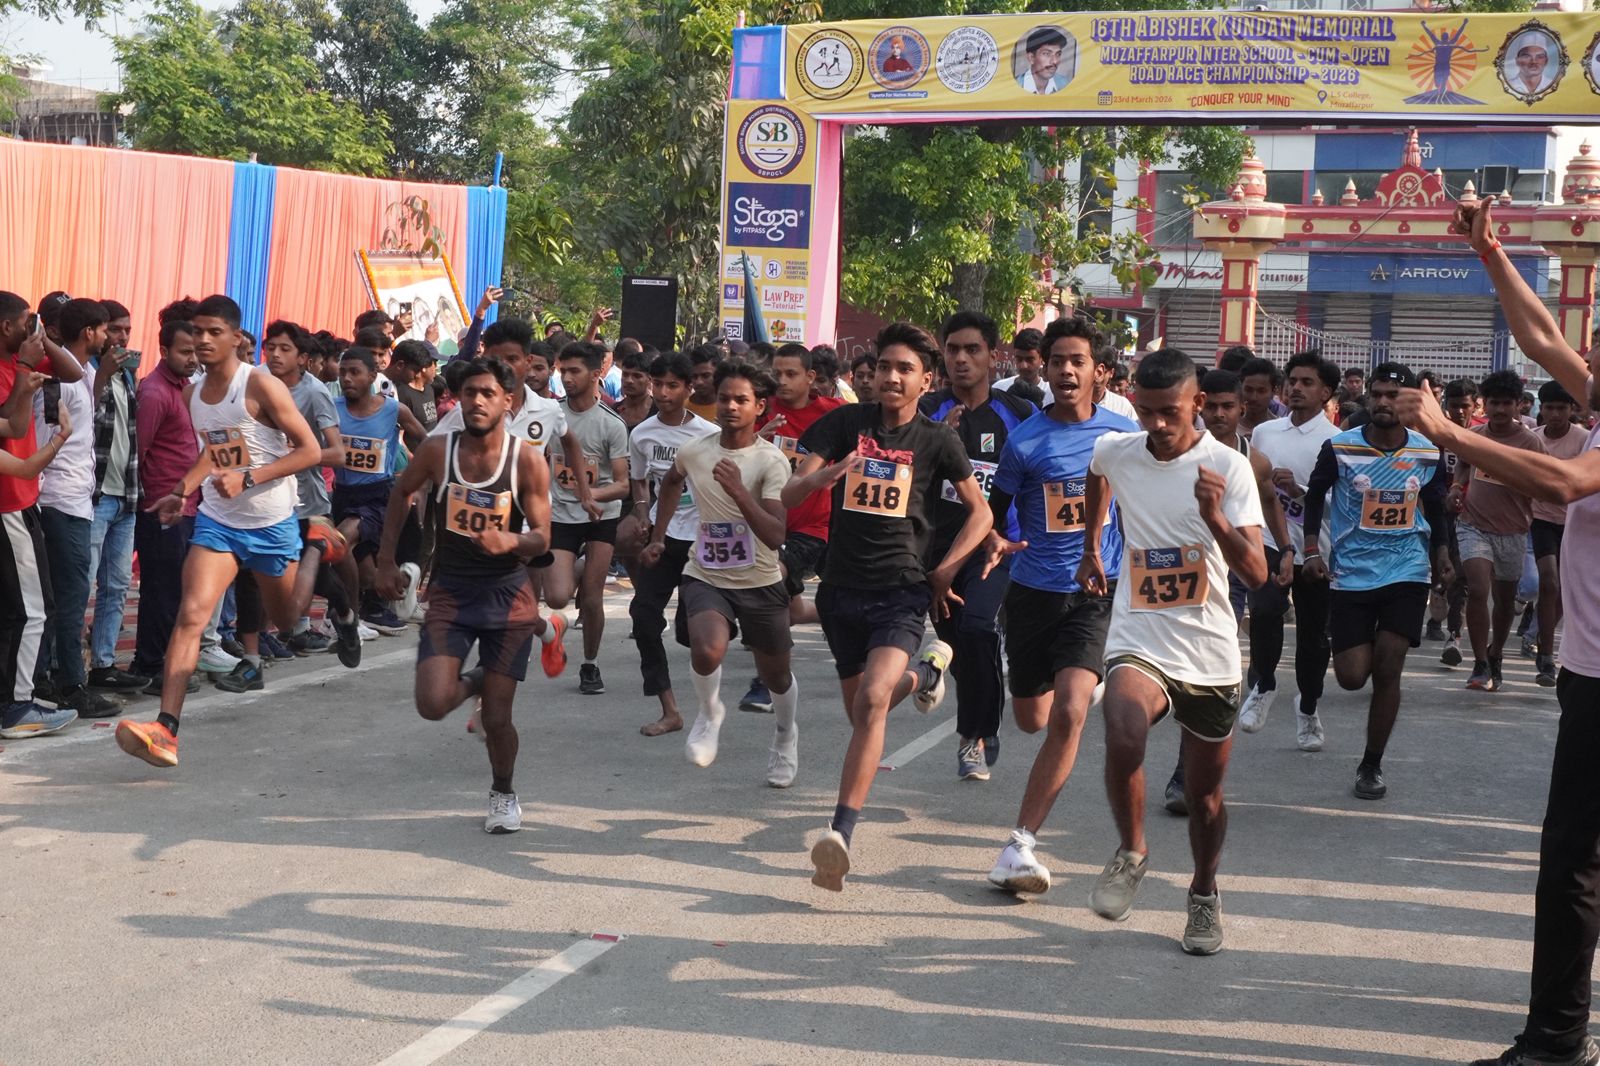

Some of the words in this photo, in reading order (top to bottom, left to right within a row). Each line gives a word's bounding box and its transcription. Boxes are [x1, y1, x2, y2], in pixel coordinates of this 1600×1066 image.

[1091, 18, 1136, 41] 16TH
[1137, 16, 1217, 40] ABISHEK
[1218, 15, 1297, 40] KUNDAN
[1298, 15, 1396, 41] MEMORIAL
[1100, 46, 1198, 64] MUZAFFARPUR
[1199, 45, 1241, 64] INTER
[1241, 45, 1296, 64] SCHOOL
[1307, 46, 1340, 65] CUM
[1350, 46, 1390, 66] OPEN
[1130, 65, 1167, 84] ROAD
[1168, 65, 1204, 84] RACE
[1205, 65, 1310, 84] CHAMPIONSHIP
[1320, 67, 1360, 85] 2026
[1113, 95, 1129, 104] 23rd
[1131, 95, 1153, 104] March
[1154, 95, 1173, 104] 2026
[1239, 93, 1263, 104] YOUR
[734, 226, 742, 234] by
[1260, 273, 1304, 283] CREATIONS
[1400, 267, 1470, 279] ARROW
[764, 289, 783, 302] LAW
[783, 290, 805, 303] PREP
[772, 302, 796, 310] Tutorial
[852, 481, 901, 510] 418
[1056, 501, 1086, 526] 41
[1369, 507, 1408, 526] 421
[703, 540, 747, 563] 354
[1139, 571, 1199, 604] 437
